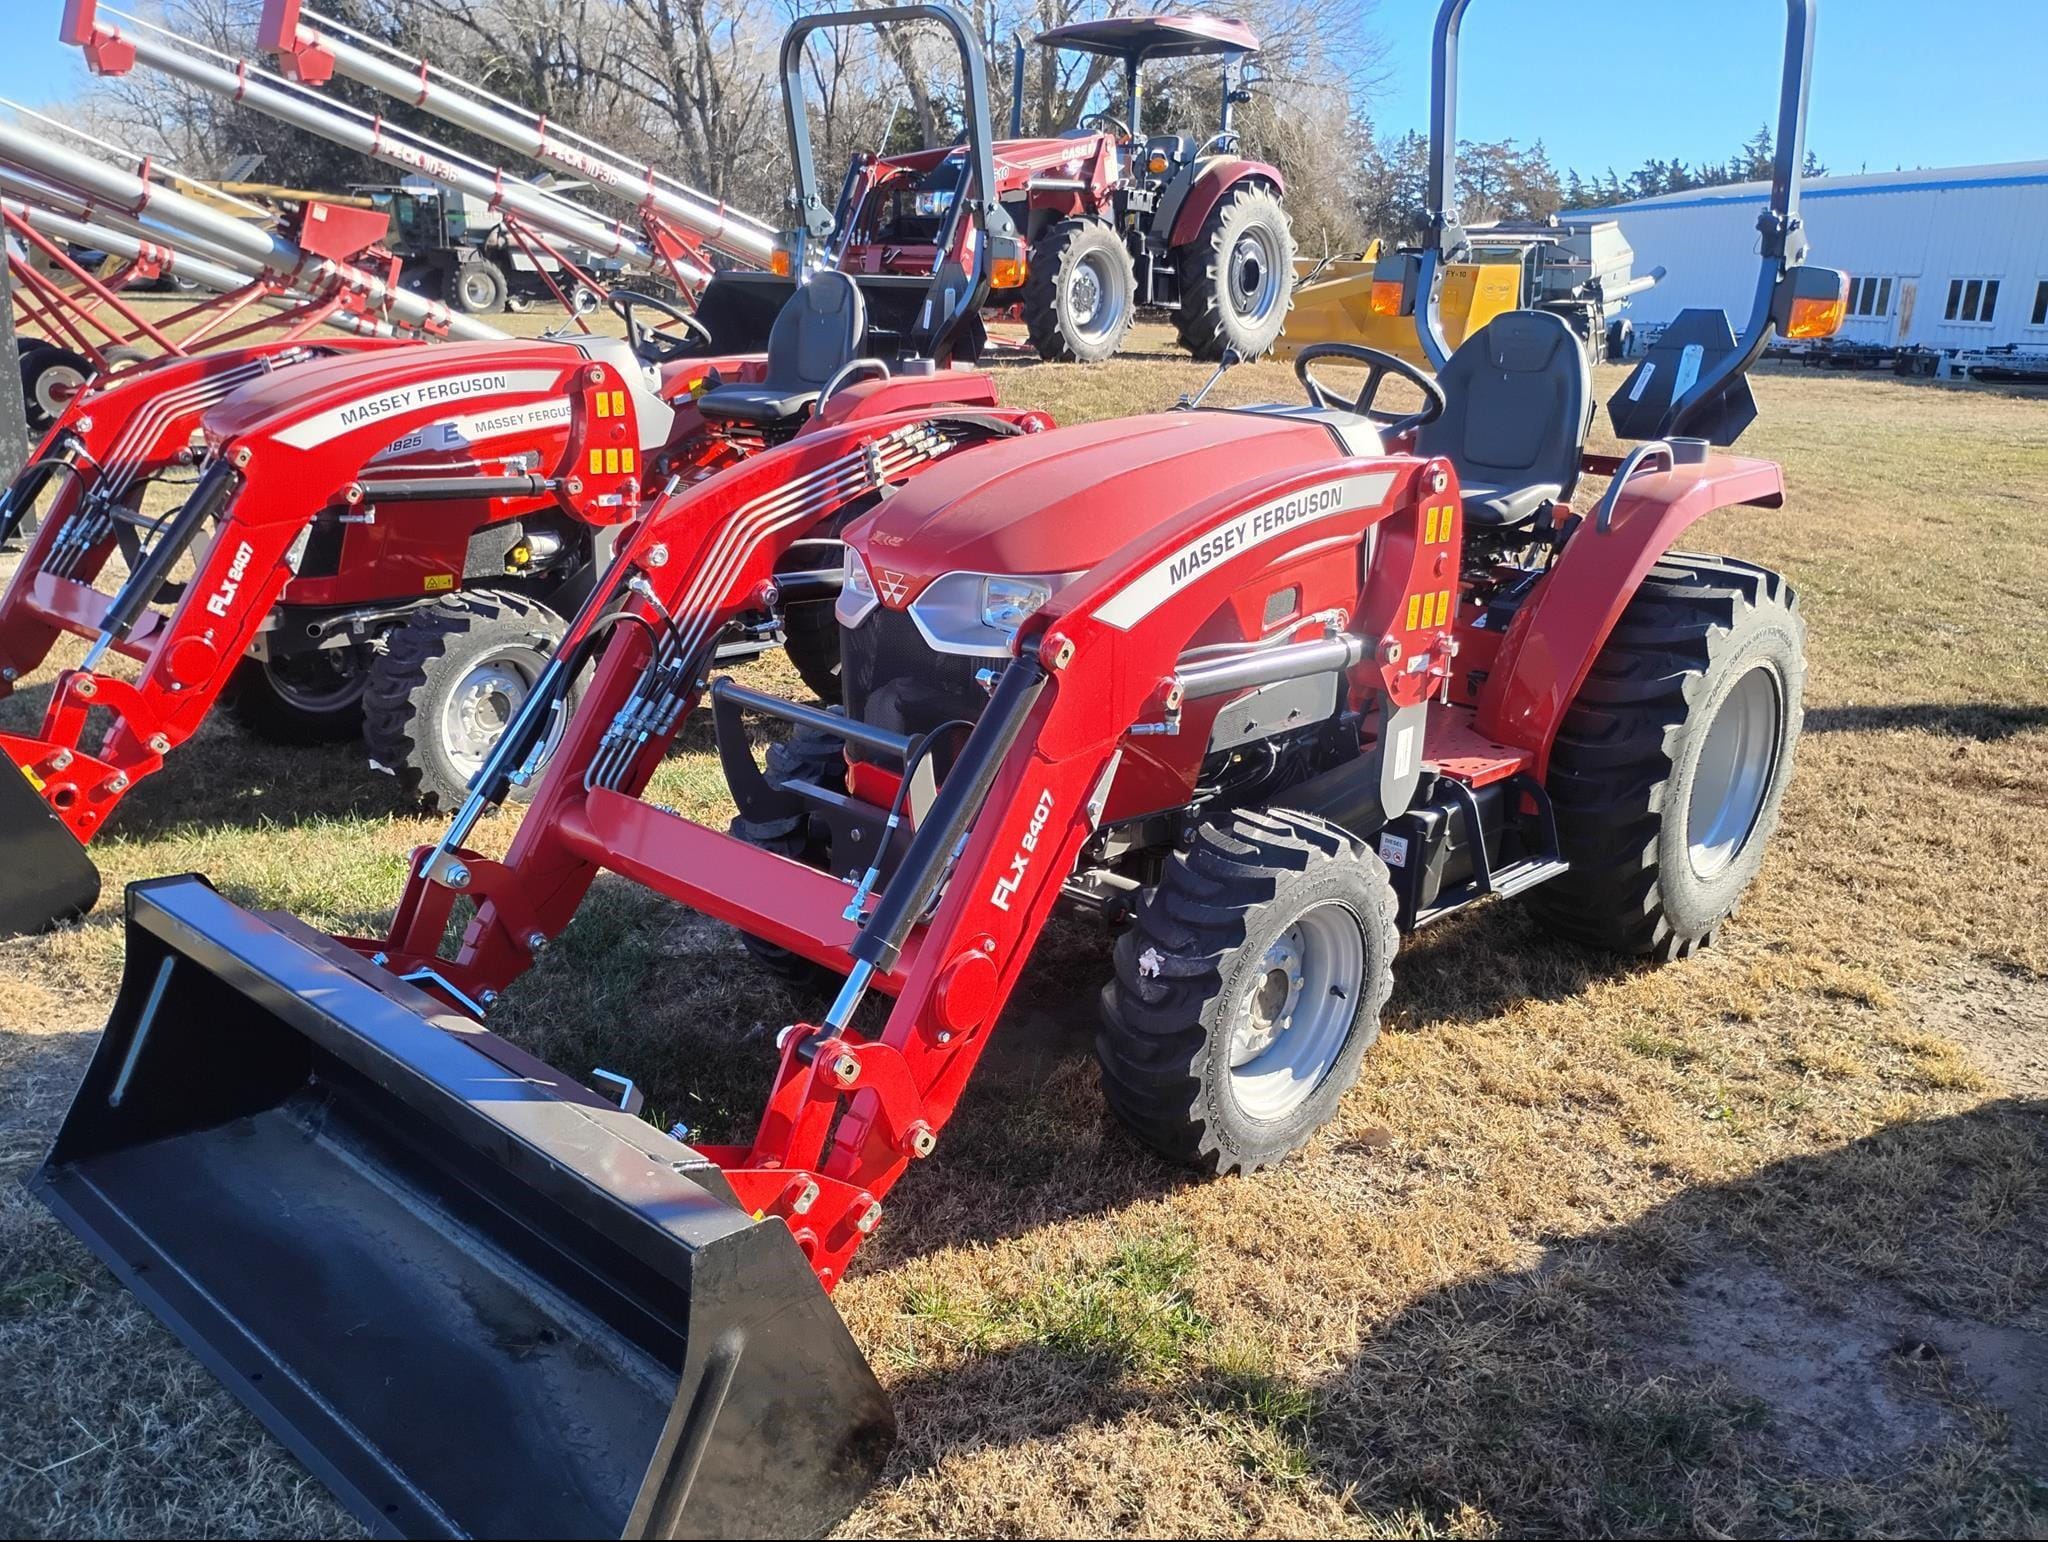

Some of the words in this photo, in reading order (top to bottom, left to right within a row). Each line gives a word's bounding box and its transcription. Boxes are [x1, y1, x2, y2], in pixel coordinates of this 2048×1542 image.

[1061, 144, 1088, 160] CASE
[340, 392, 411, 425] MASSEY
[417, 375, 506, 402] FERGUSON
[475, 414, 525, 433] MASSEY
[388, 435, 422, 453] 1825
[443, 423, 460, 443] E
[1169, 522, 1246, 585] MASSEY
[1253, 486, 1342, 537] FERGUSON
[206, 578, 238, 617] FLX
[227, 540, 254, 582] 2407
[990, 851, 1030, 911] FLX
[1021, 788, 1054, 853] 2407
